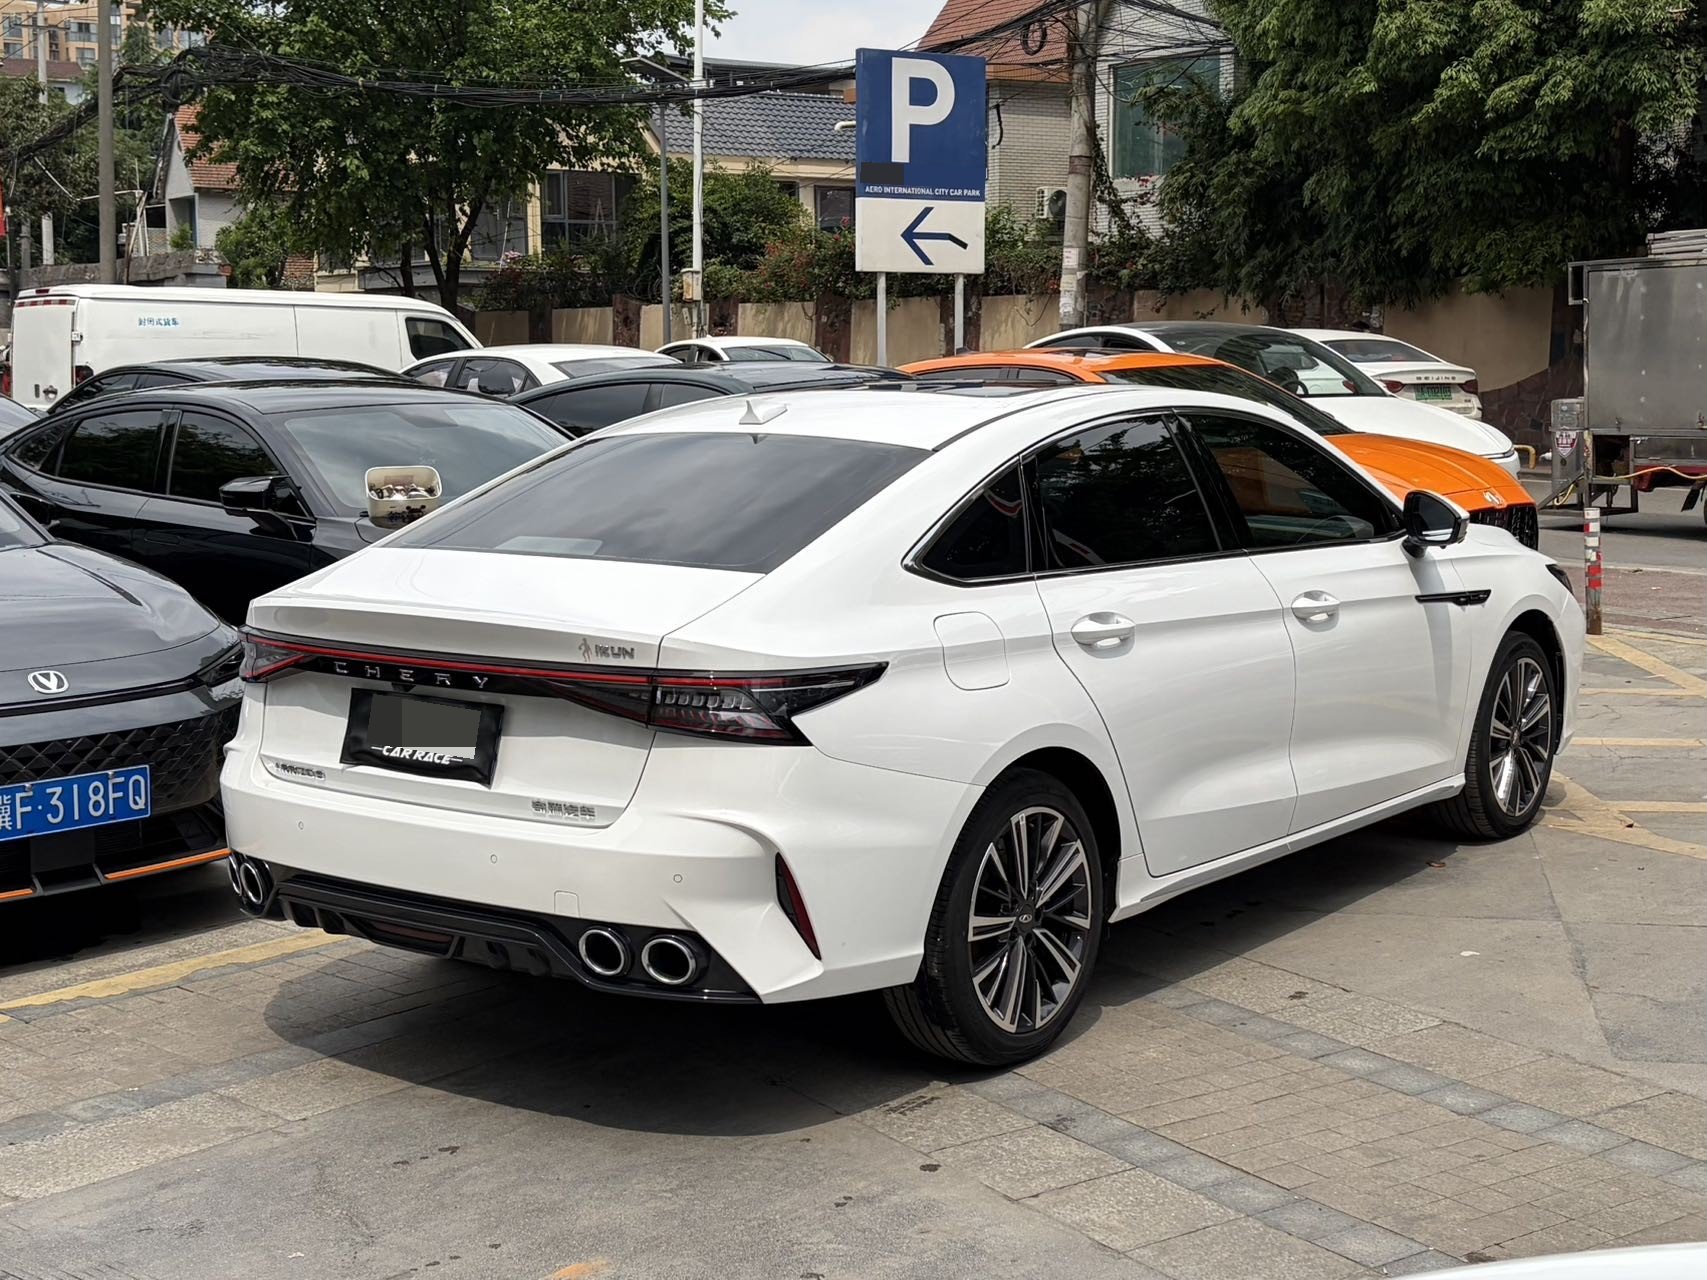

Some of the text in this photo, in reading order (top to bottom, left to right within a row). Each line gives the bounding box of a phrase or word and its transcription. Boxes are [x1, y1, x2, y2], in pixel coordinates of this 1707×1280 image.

[891, 57, 955, 163] P
[864, 185, 981, 197] AERO INTERNATIONAL CITY CAR PARK
[595, 644, 635, 660] IKUN
[334, 661, 489, 688] CHERY
[382, 746, 451, 765] CAR RACE
